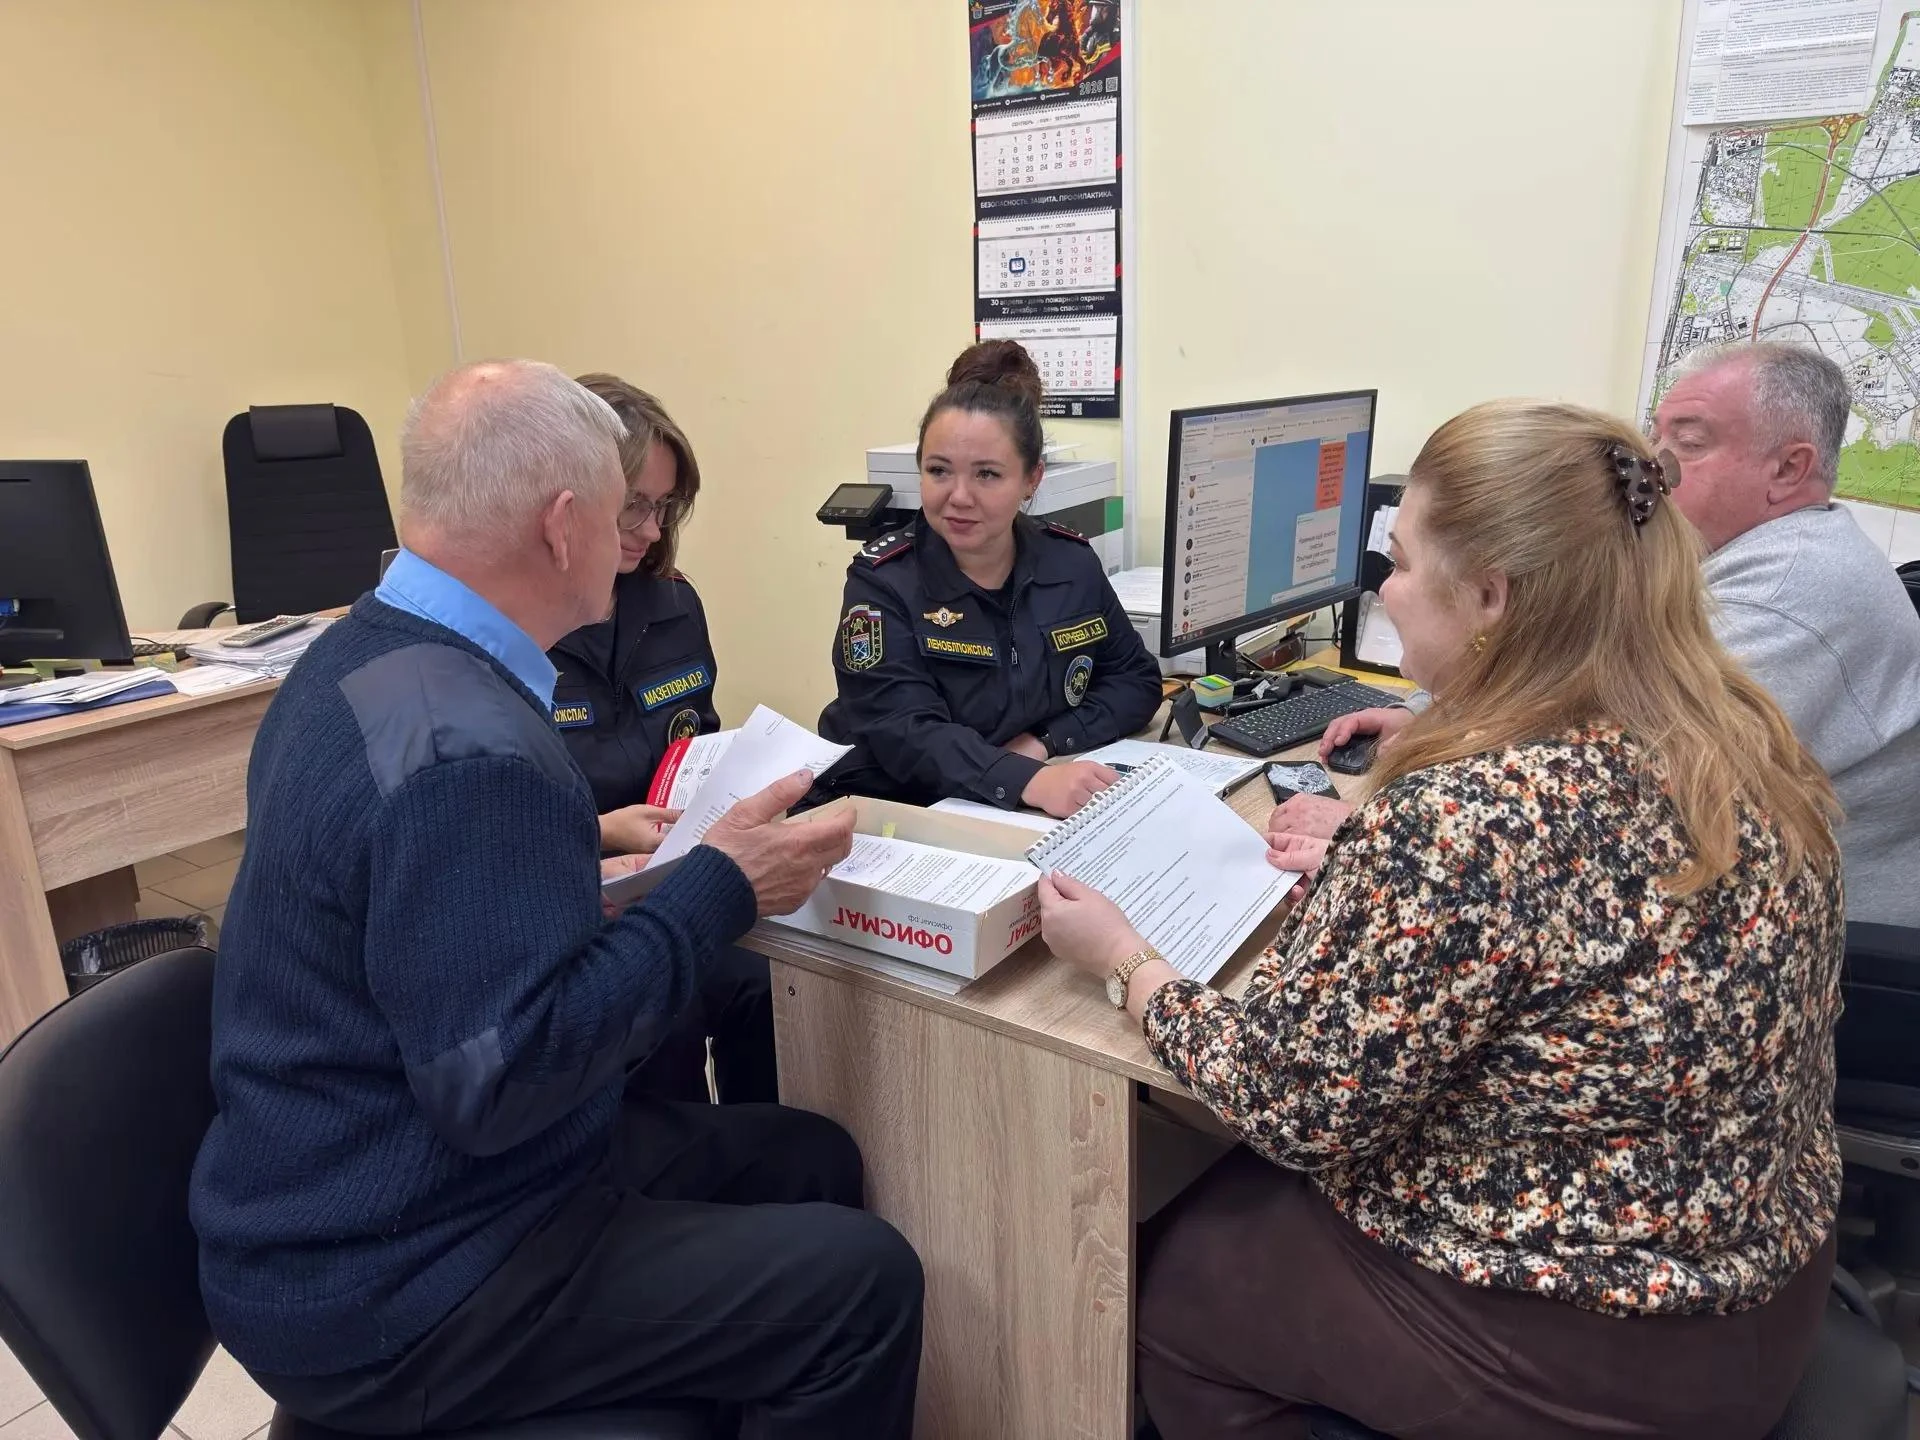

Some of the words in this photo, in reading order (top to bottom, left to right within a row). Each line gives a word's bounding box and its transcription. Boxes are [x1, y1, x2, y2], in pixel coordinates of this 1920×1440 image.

[1057, 627, 1090, 646] КОРНЕЕВА
[1090, 623, 1104, 636] А.В.
[927, 638, 993, 657] ЛЕНОБЛПОЖСПАС
[644, 677, 690, 705] МАЗЕПОВА
[688, 671, 706, 687] Ю.Р.
[834, 907, 953, 955] ОФИСМАГ
[907, 914, 953, 931] офисмаг.рф
